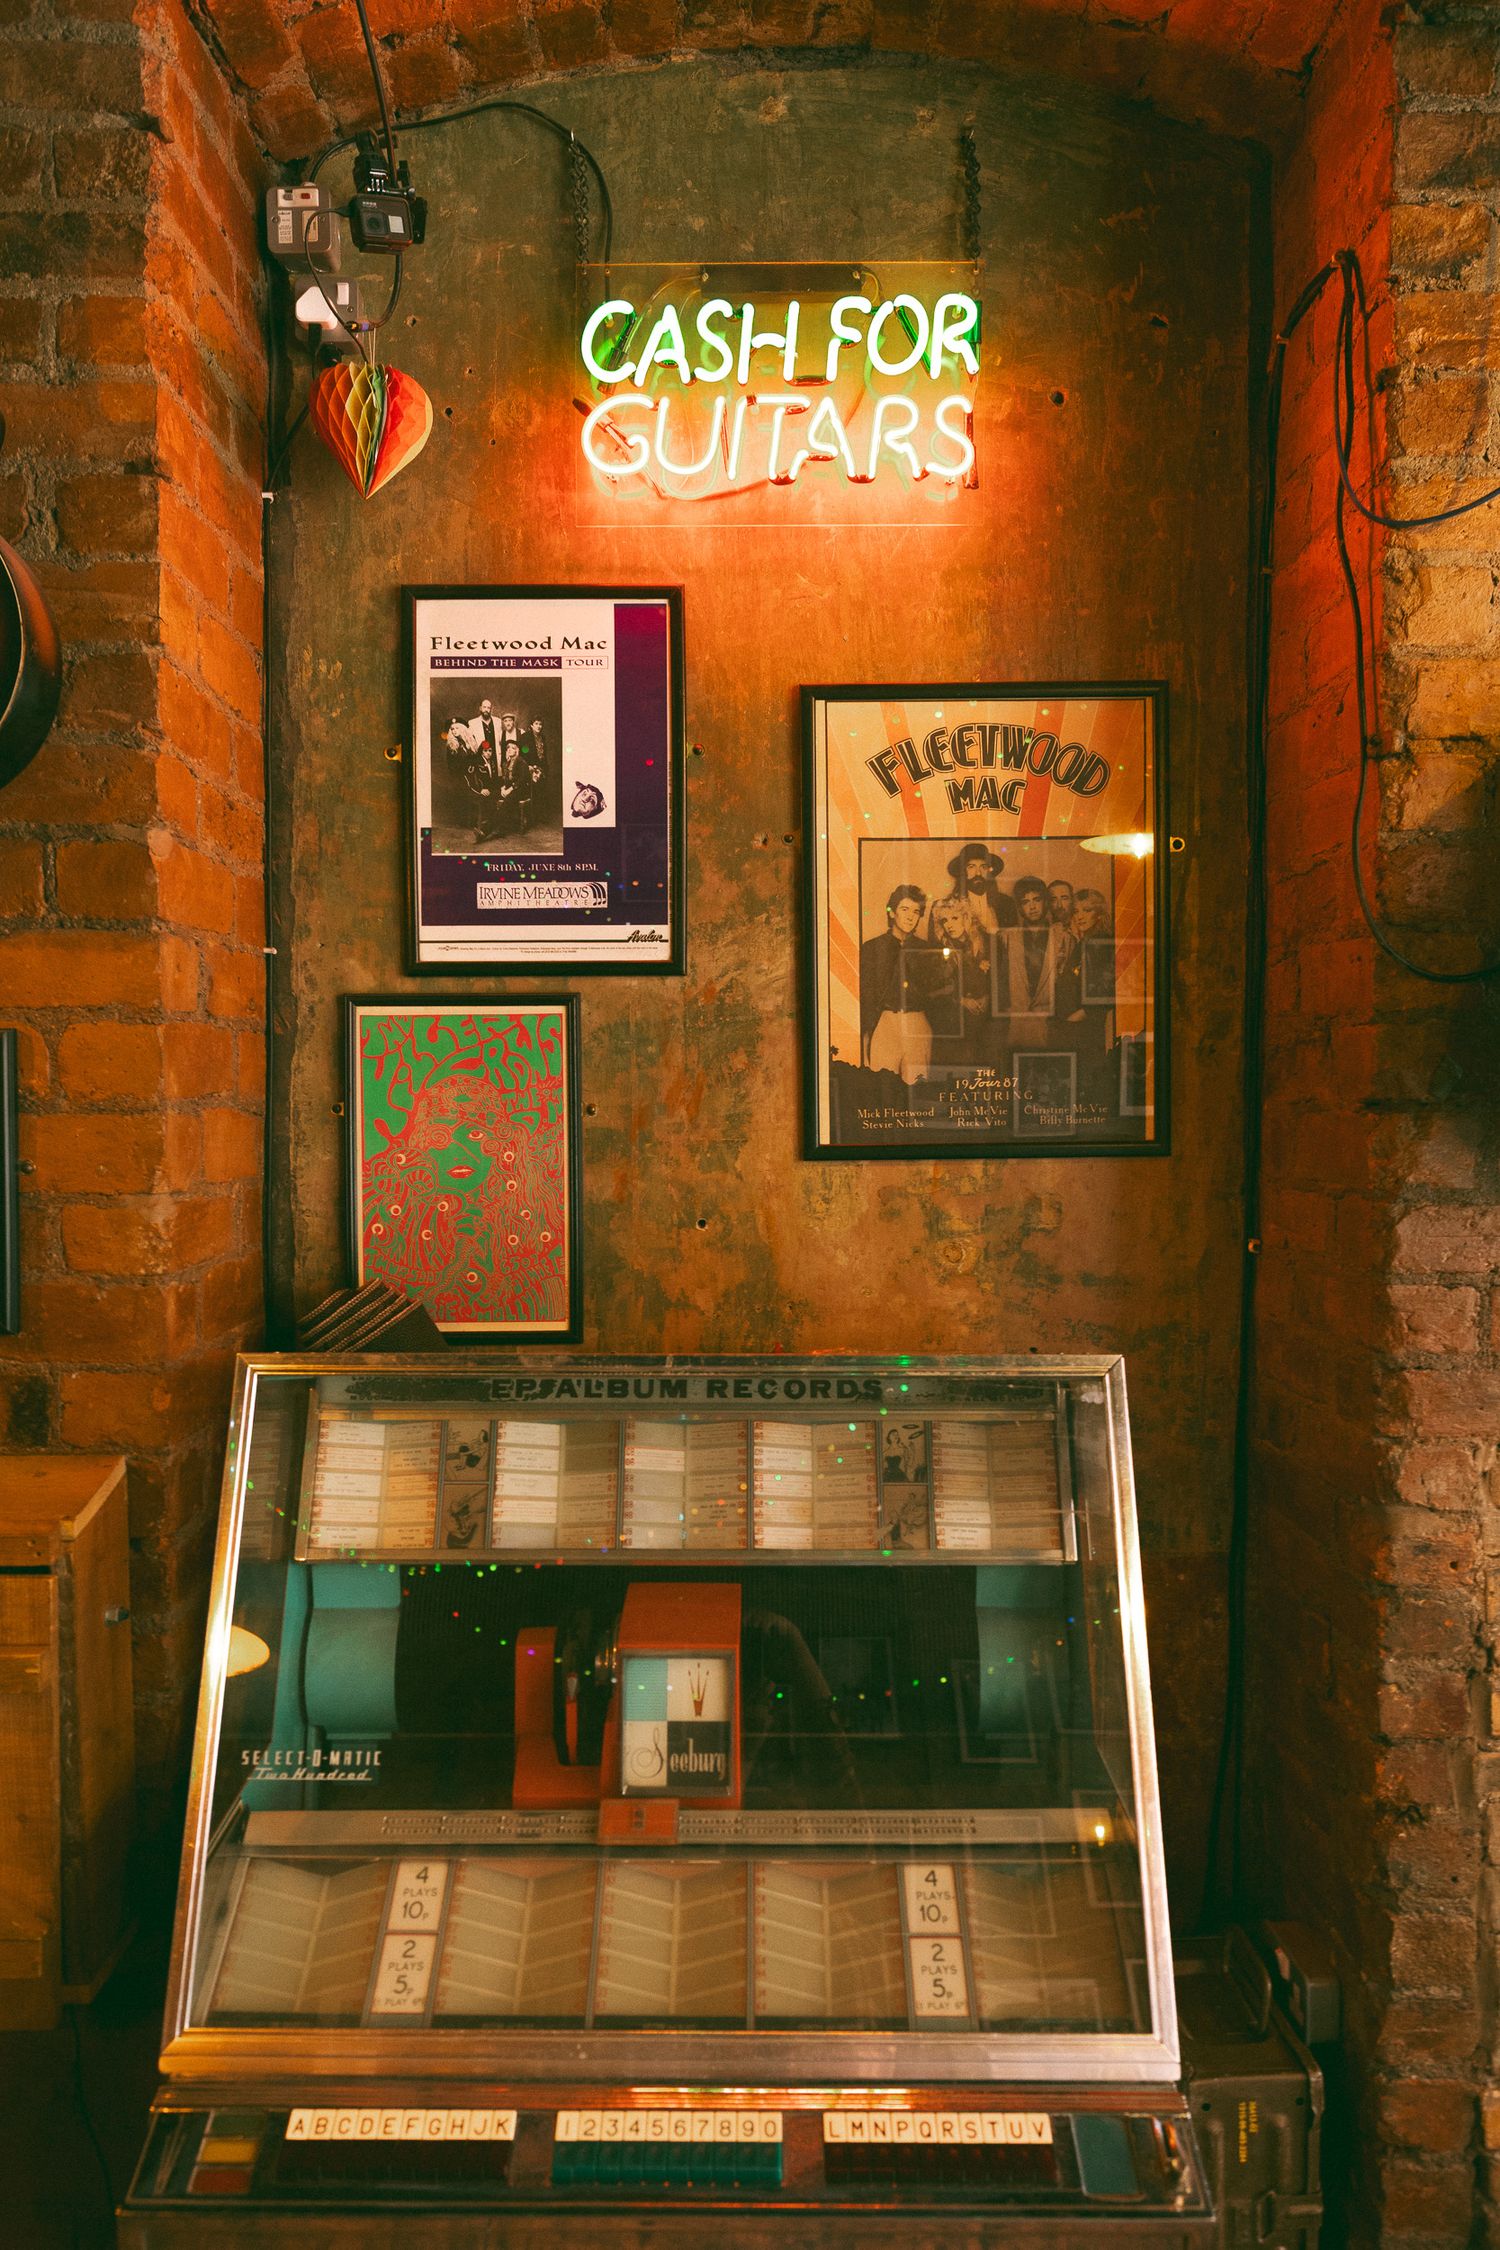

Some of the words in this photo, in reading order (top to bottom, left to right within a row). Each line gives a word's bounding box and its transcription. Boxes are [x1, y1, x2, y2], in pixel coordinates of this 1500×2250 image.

[580, 298, 800, 386] CASH
[829, 293, 980, 382] FOR
[580, 394, 976, 481] GUITARS
[430, 636, 552, 650] Fleetwood
[560, 636, 607, 650] Mac
[435, 658, 488, 667] BEHIND
[491, 658, 517, 667] THE
[521, 658, 559, 667] MASK
[864, 722, 1111, 799] FLEETWOOD
[945, 775, 1027, 815] MAC
[528, 863, 555, 871] JUNE
[479, 886, 521, 900] IRVINE
[522, 886, 589, 899] MEADOWS
[976, 1069, 996, 1077] THE
[939, 1090, 1033, 1102] FEATURING
[857, 1108, 881, 1119] Mick
[884, 1106, 935, 1118] Fleetwood
[948, 1106, 970, 1119] John
[1024, 1104, 1069, 1116] Christine
[862, 1119, 893, 1130] Stevie
[896, 1118, 926, 1129] Nicks
[957, 1117, 980, 1128] Rick
[984, 1116, 1007, 1127] Vito
[1040, 1115, 1062, 1126] Billy
[1065, 1114, 1106, 1126] Burnette
[706, 1378, 883, 1400] RECORDS
[241, 1749, 382, 1767] SELECT-O-MATIC
[627, 1727, 727, 1781] Seeburg
[416, 1866, 429, 1884] 4
[924, 1870, 938, 1887] 4
[403, 1888, 438, 1897] PLAYS
[916, 1891, 951, 1900] PLAYS
[402, 1939, 416, 1959] 2
[931, 1943, 945, 1962] 2
[388, 1962, 425, 1972] PLAYS
[921, 1965, 957, 1975] PLAYS
